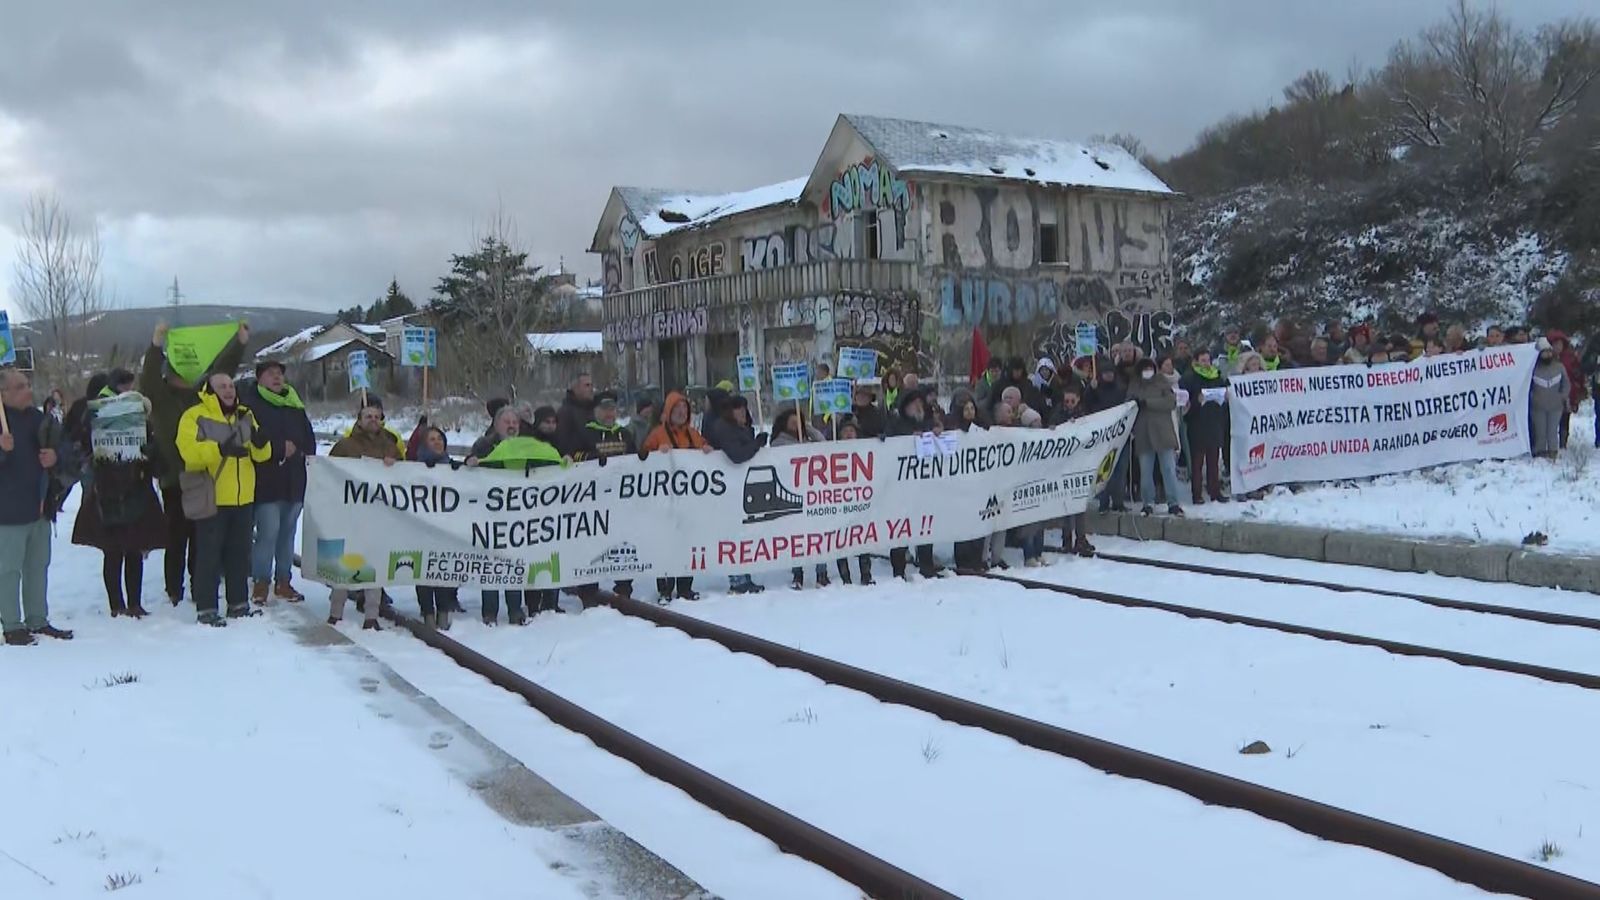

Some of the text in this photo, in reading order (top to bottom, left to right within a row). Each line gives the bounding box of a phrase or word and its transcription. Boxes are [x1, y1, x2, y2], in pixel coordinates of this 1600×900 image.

[1234, 378, 1278, 398] NUESTRO
[1279, 377, 1306, 394] TREN,
[1308, 373, 1364, 391] NUESTRO
[1367, 367, 1423, 387] DERECHO,
[1425, 358, 1477, 380] NUESTRA
[1479, 352, 1516, 370] LUCHA
[1250, 385, 1512, 435] ARANDA NECESITA TREN DIRECTO ¡YA!
[897, 453, 944, 481] TREN
[949, 443, 1015, 476] DIRECTO
[1018, 436, 1080, 465] MADRID
[1270, 441, 1328, 460] IZQUIERDA
[1330, 438, 1370, 455] UNIDA
[1373, 432, 1420, 452] ARANDA
[1422, 430, 1438, 445] DE
[790, 451, 874, 488] TREN
[344, 479, 460, 513] MADRID
[486, 480, 597, 512] SEGOVIA
[619, 469, 727, 499] BURGOS
[807, 486, 873, 506] DIRECTO
[1012, 481, 1059, 501] SONORAMA
[1063, 475, 1094, 489] RIBER
[806, 506, 838, 517] MADRID
[843, 502, 871, 514] BURGOS
[472, 509, 610, 550] NECESITAN
[718, 522, 878, 565] REAPERTURA
[885, 518, 912, 540] YA
[427, 559, 525, 576] FC DIRECTO
[428, 551, 489, 561] PLATAFORMA
[425, 571, 469, 582] MADRID
[480, 576, 524, 585] BURGOS
